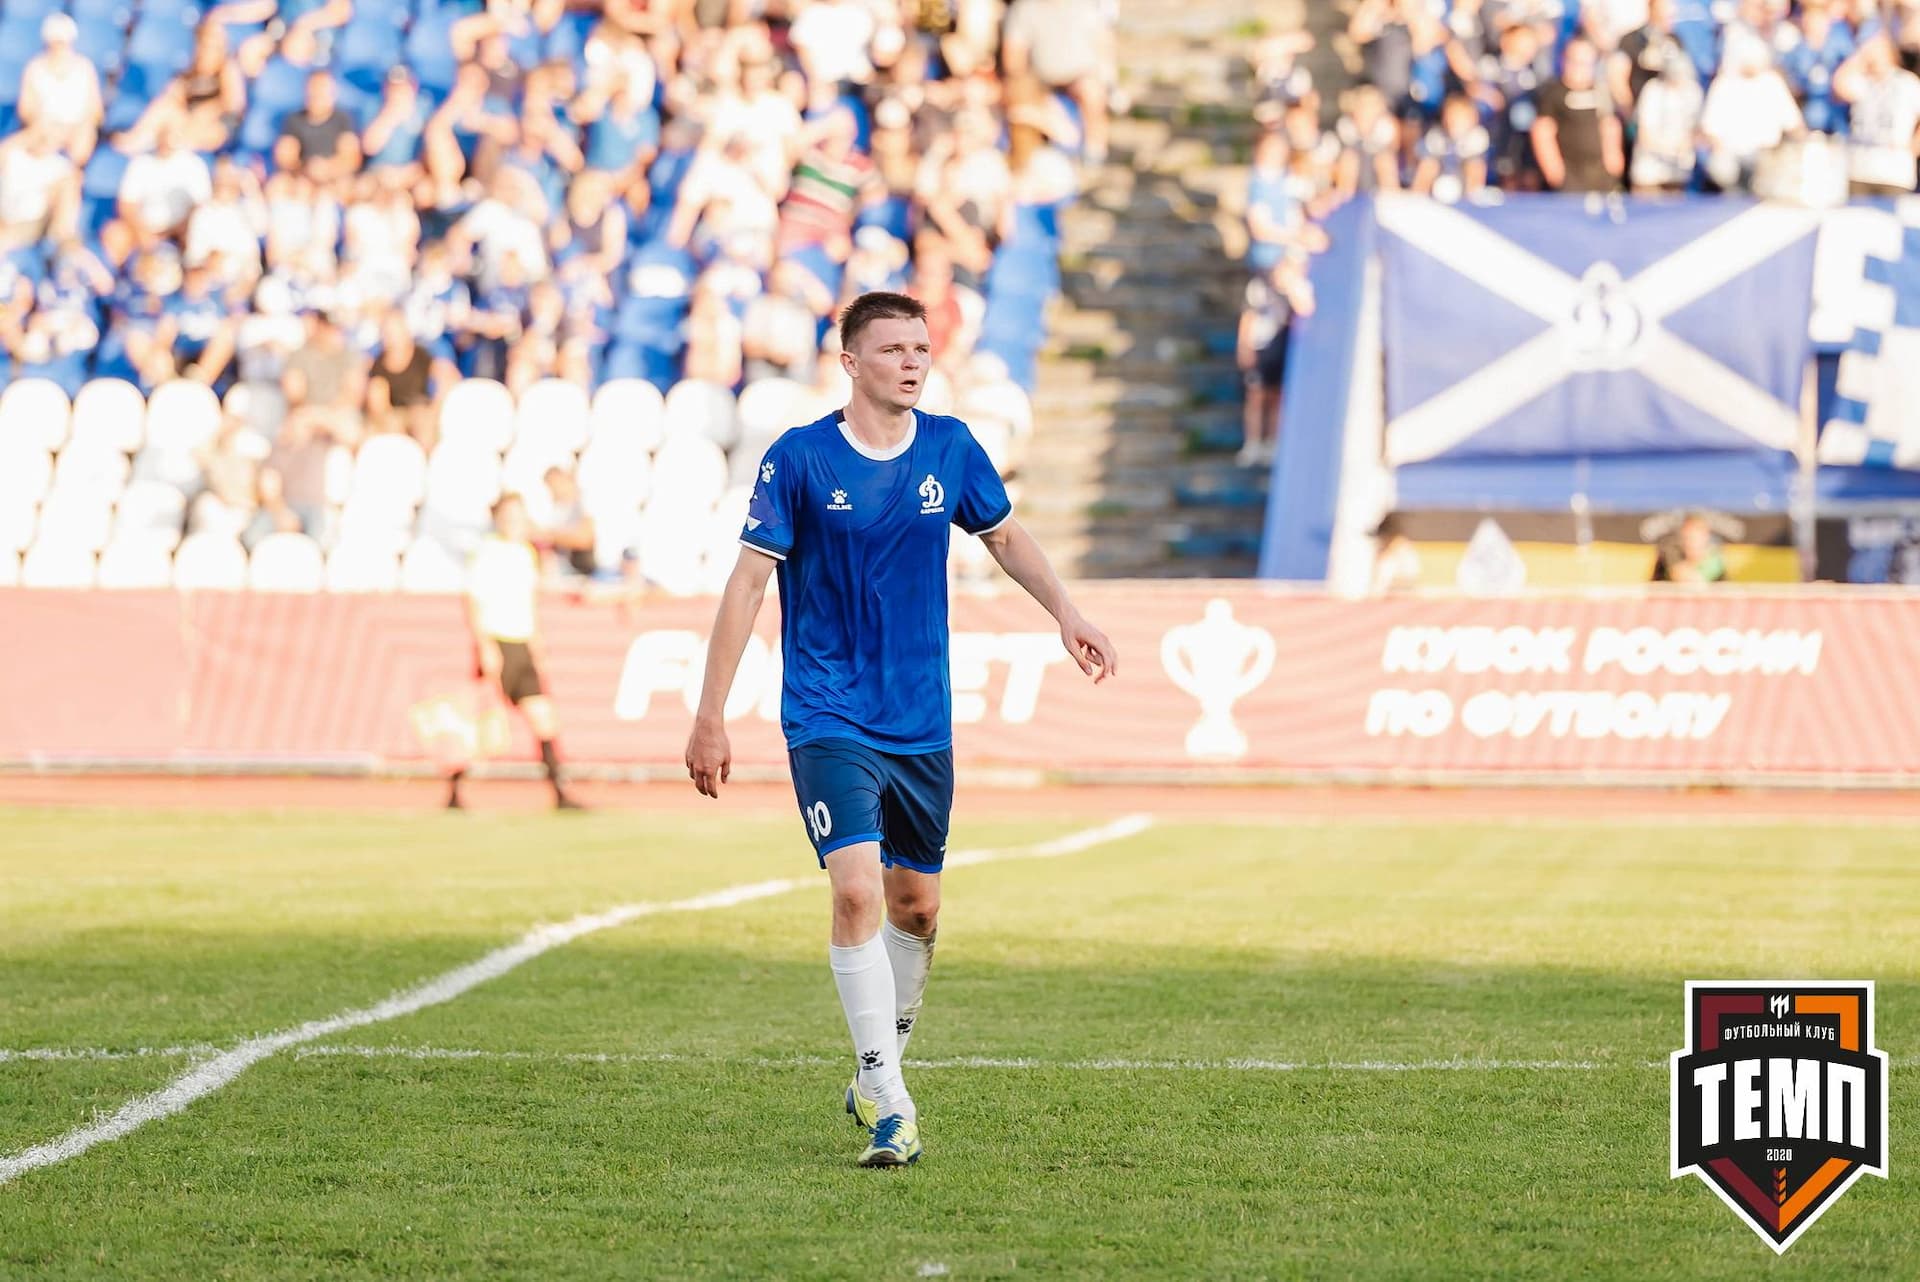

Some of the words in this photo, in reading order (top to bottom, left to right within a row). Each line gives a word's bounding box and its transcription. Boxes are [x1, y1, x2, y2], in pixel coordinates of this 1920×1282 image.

[1382, 626, 1575, 673] КУБОК
[1583, 627, 1823, 675] РОССИИ
[1365, 689, 1453, 736] ПО
[1461, 690, 1731, 739] ФУТБОЛУ
